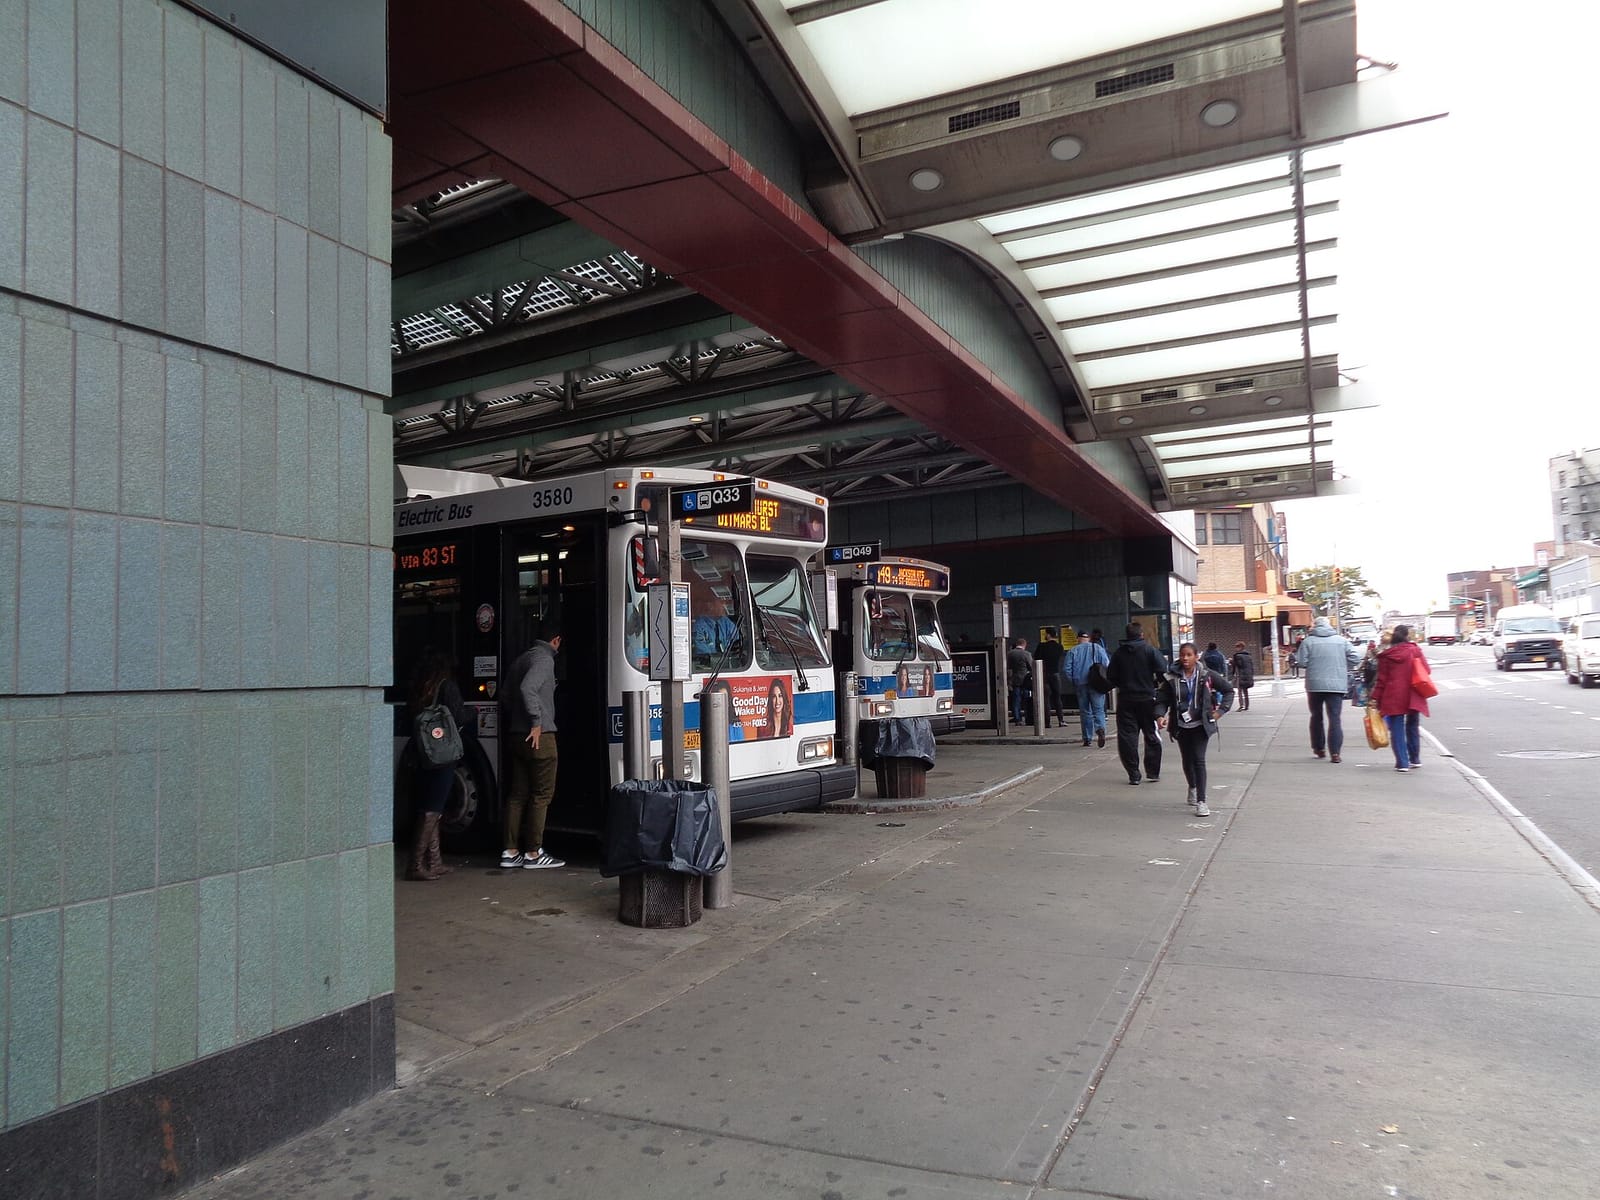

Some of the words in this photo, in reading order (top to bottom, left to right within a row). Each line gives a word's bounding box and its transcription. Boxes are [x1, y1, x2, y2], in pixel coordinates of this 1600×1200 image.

[533, 486, 573, 509] 3580
[712, 487, 740, 504] Q33
[398, 505, 445, 528] Electric
[448, 503, 473, 521] Bus
[760, 516, 771, 531] BL
[401, 555, 420, 569] VIA
[423, 547, 438, 567] 83
[441, 545, 456, 565] ST
[852, 546, 872, 557] Q49
[954, 665, 980, 673] LIABLE
[952, 673, 968, 681] ORK
[732, 696, 754, 707] Good
[754, 695, 769, 707] Day
[649, 708, 662, 719] 358
[734, 706, 755, 717] Wake
[756, 705, 767, 717] Up
